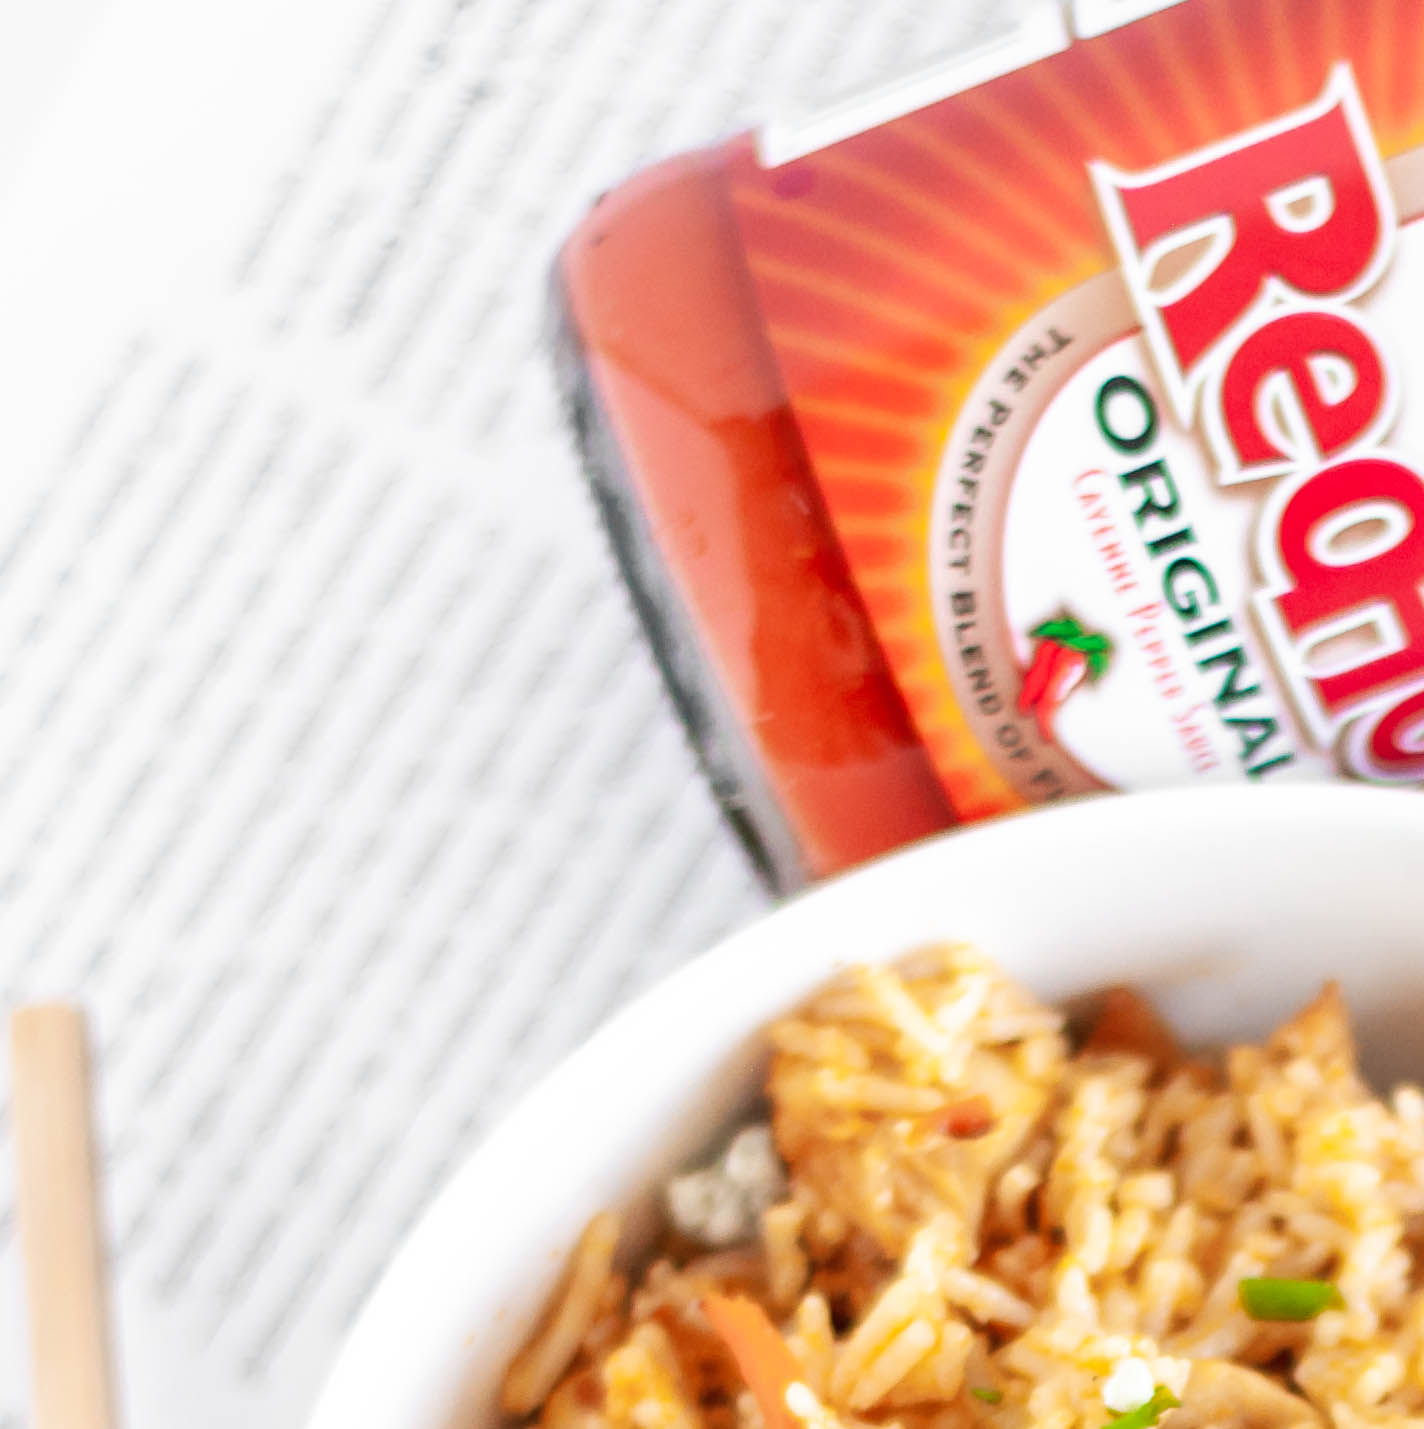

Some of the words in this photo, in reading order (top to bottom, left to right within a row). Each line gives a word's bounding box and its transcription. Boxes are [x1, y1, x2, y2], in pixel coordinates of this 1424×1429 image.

[1003, 328, 1072, 392] THE
[946, 399, 1011, 571] PERFECT
[1094, 374, 1295, 782] ORIGINAL
[950, 591, 997, 715] BLEND
